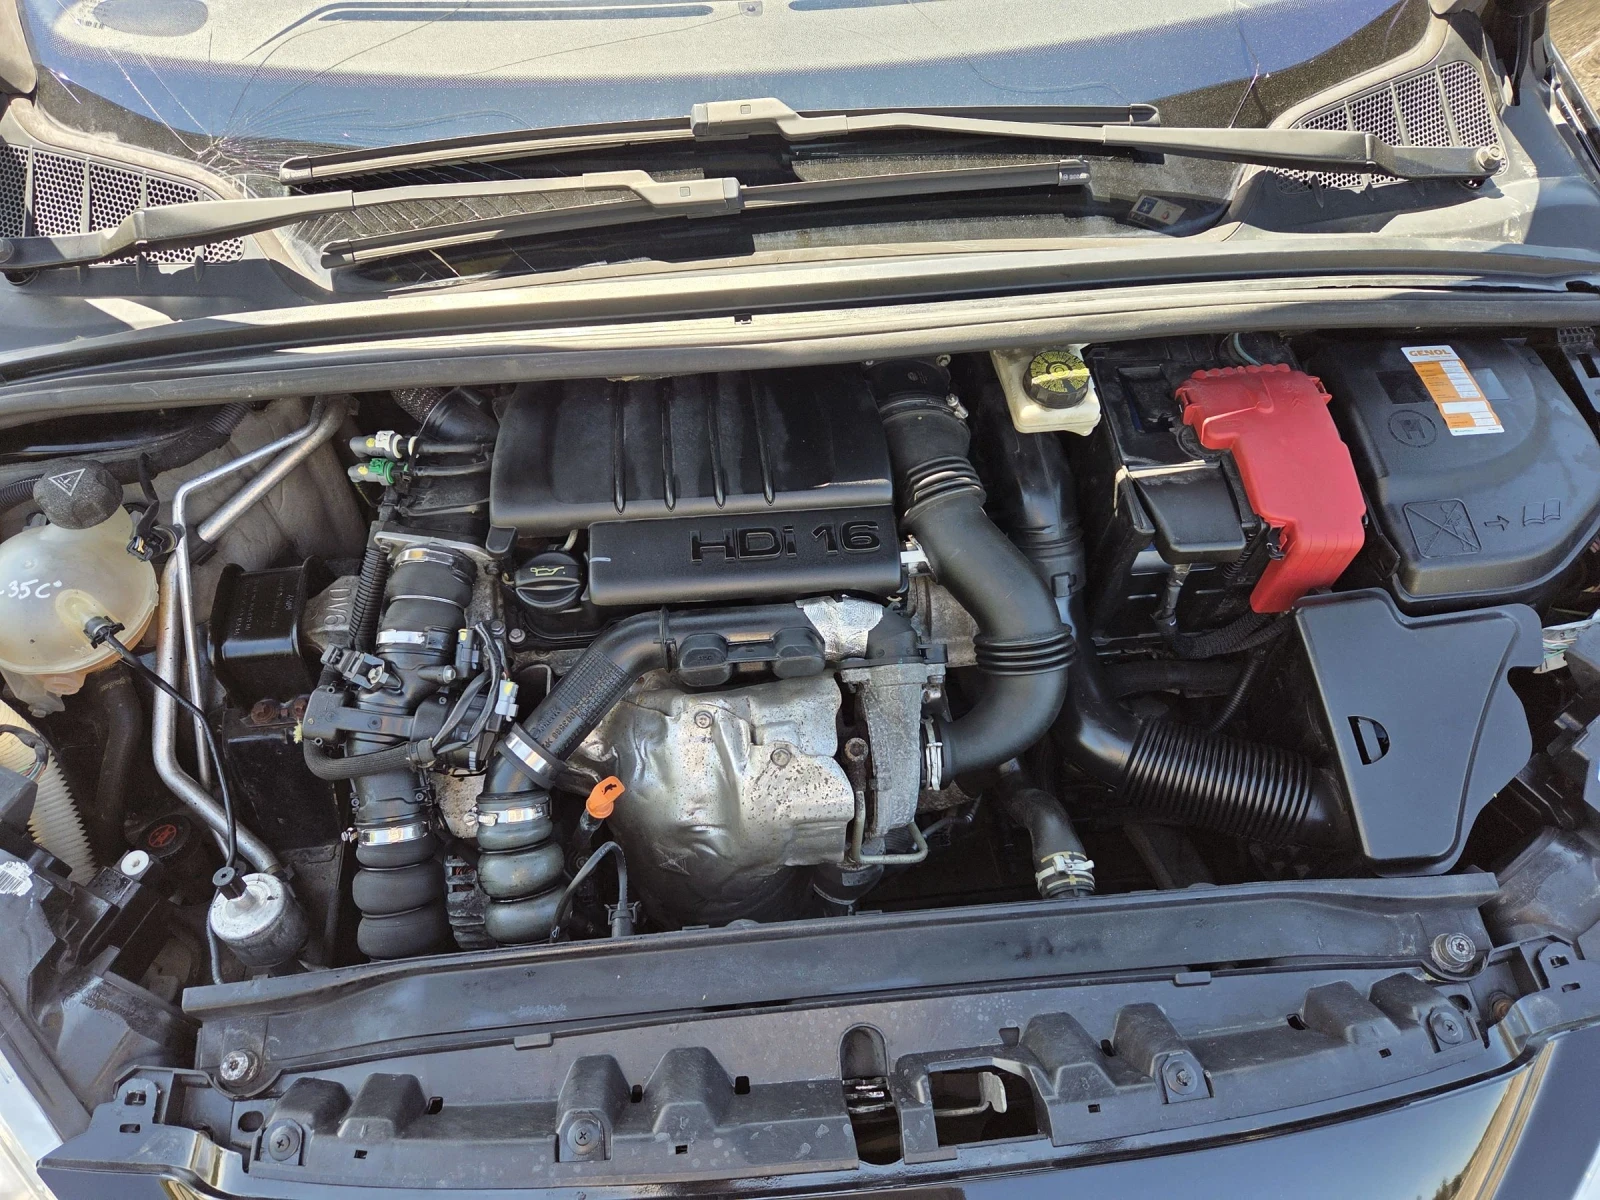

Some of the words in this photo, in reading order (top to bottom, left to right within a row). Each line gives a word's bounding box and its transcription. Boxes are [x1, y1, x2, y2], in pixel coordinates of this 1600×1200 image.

[690, 525, 797, 564] HDi
[811, 520, 880, 555] 16
[324, 588, 351, 626] DV6
